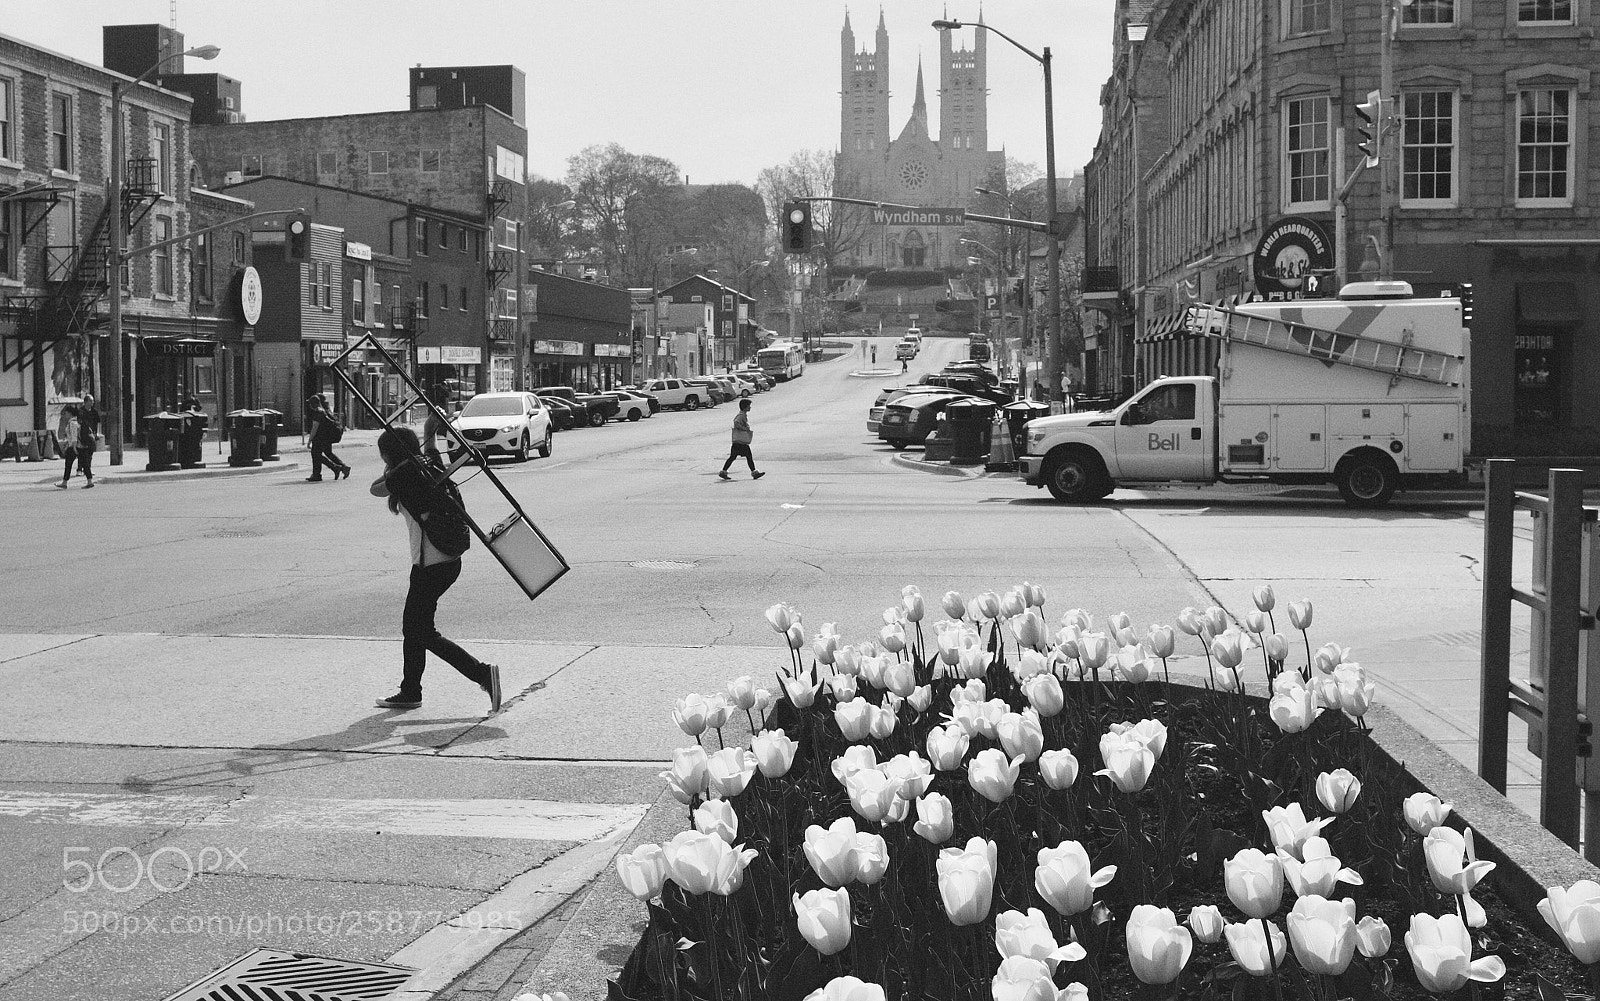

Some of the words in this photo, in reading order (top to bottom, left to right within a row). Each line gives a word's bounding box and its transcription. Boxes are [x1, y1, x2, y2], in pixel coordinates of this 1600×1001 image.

[874, 210, 940, 225] Wyndham
[944, 215, 954, 223] St
[955, 215, 962, 223] N
[1260, 231, 1280, 257] WORLD
[1278, 224, 1325, 255] HEADQUARTERS
[988, 298, 996, 309] P
[163, 344, 207, 354] DSTRCT
[1148, 432, 1180, 451] Bell
